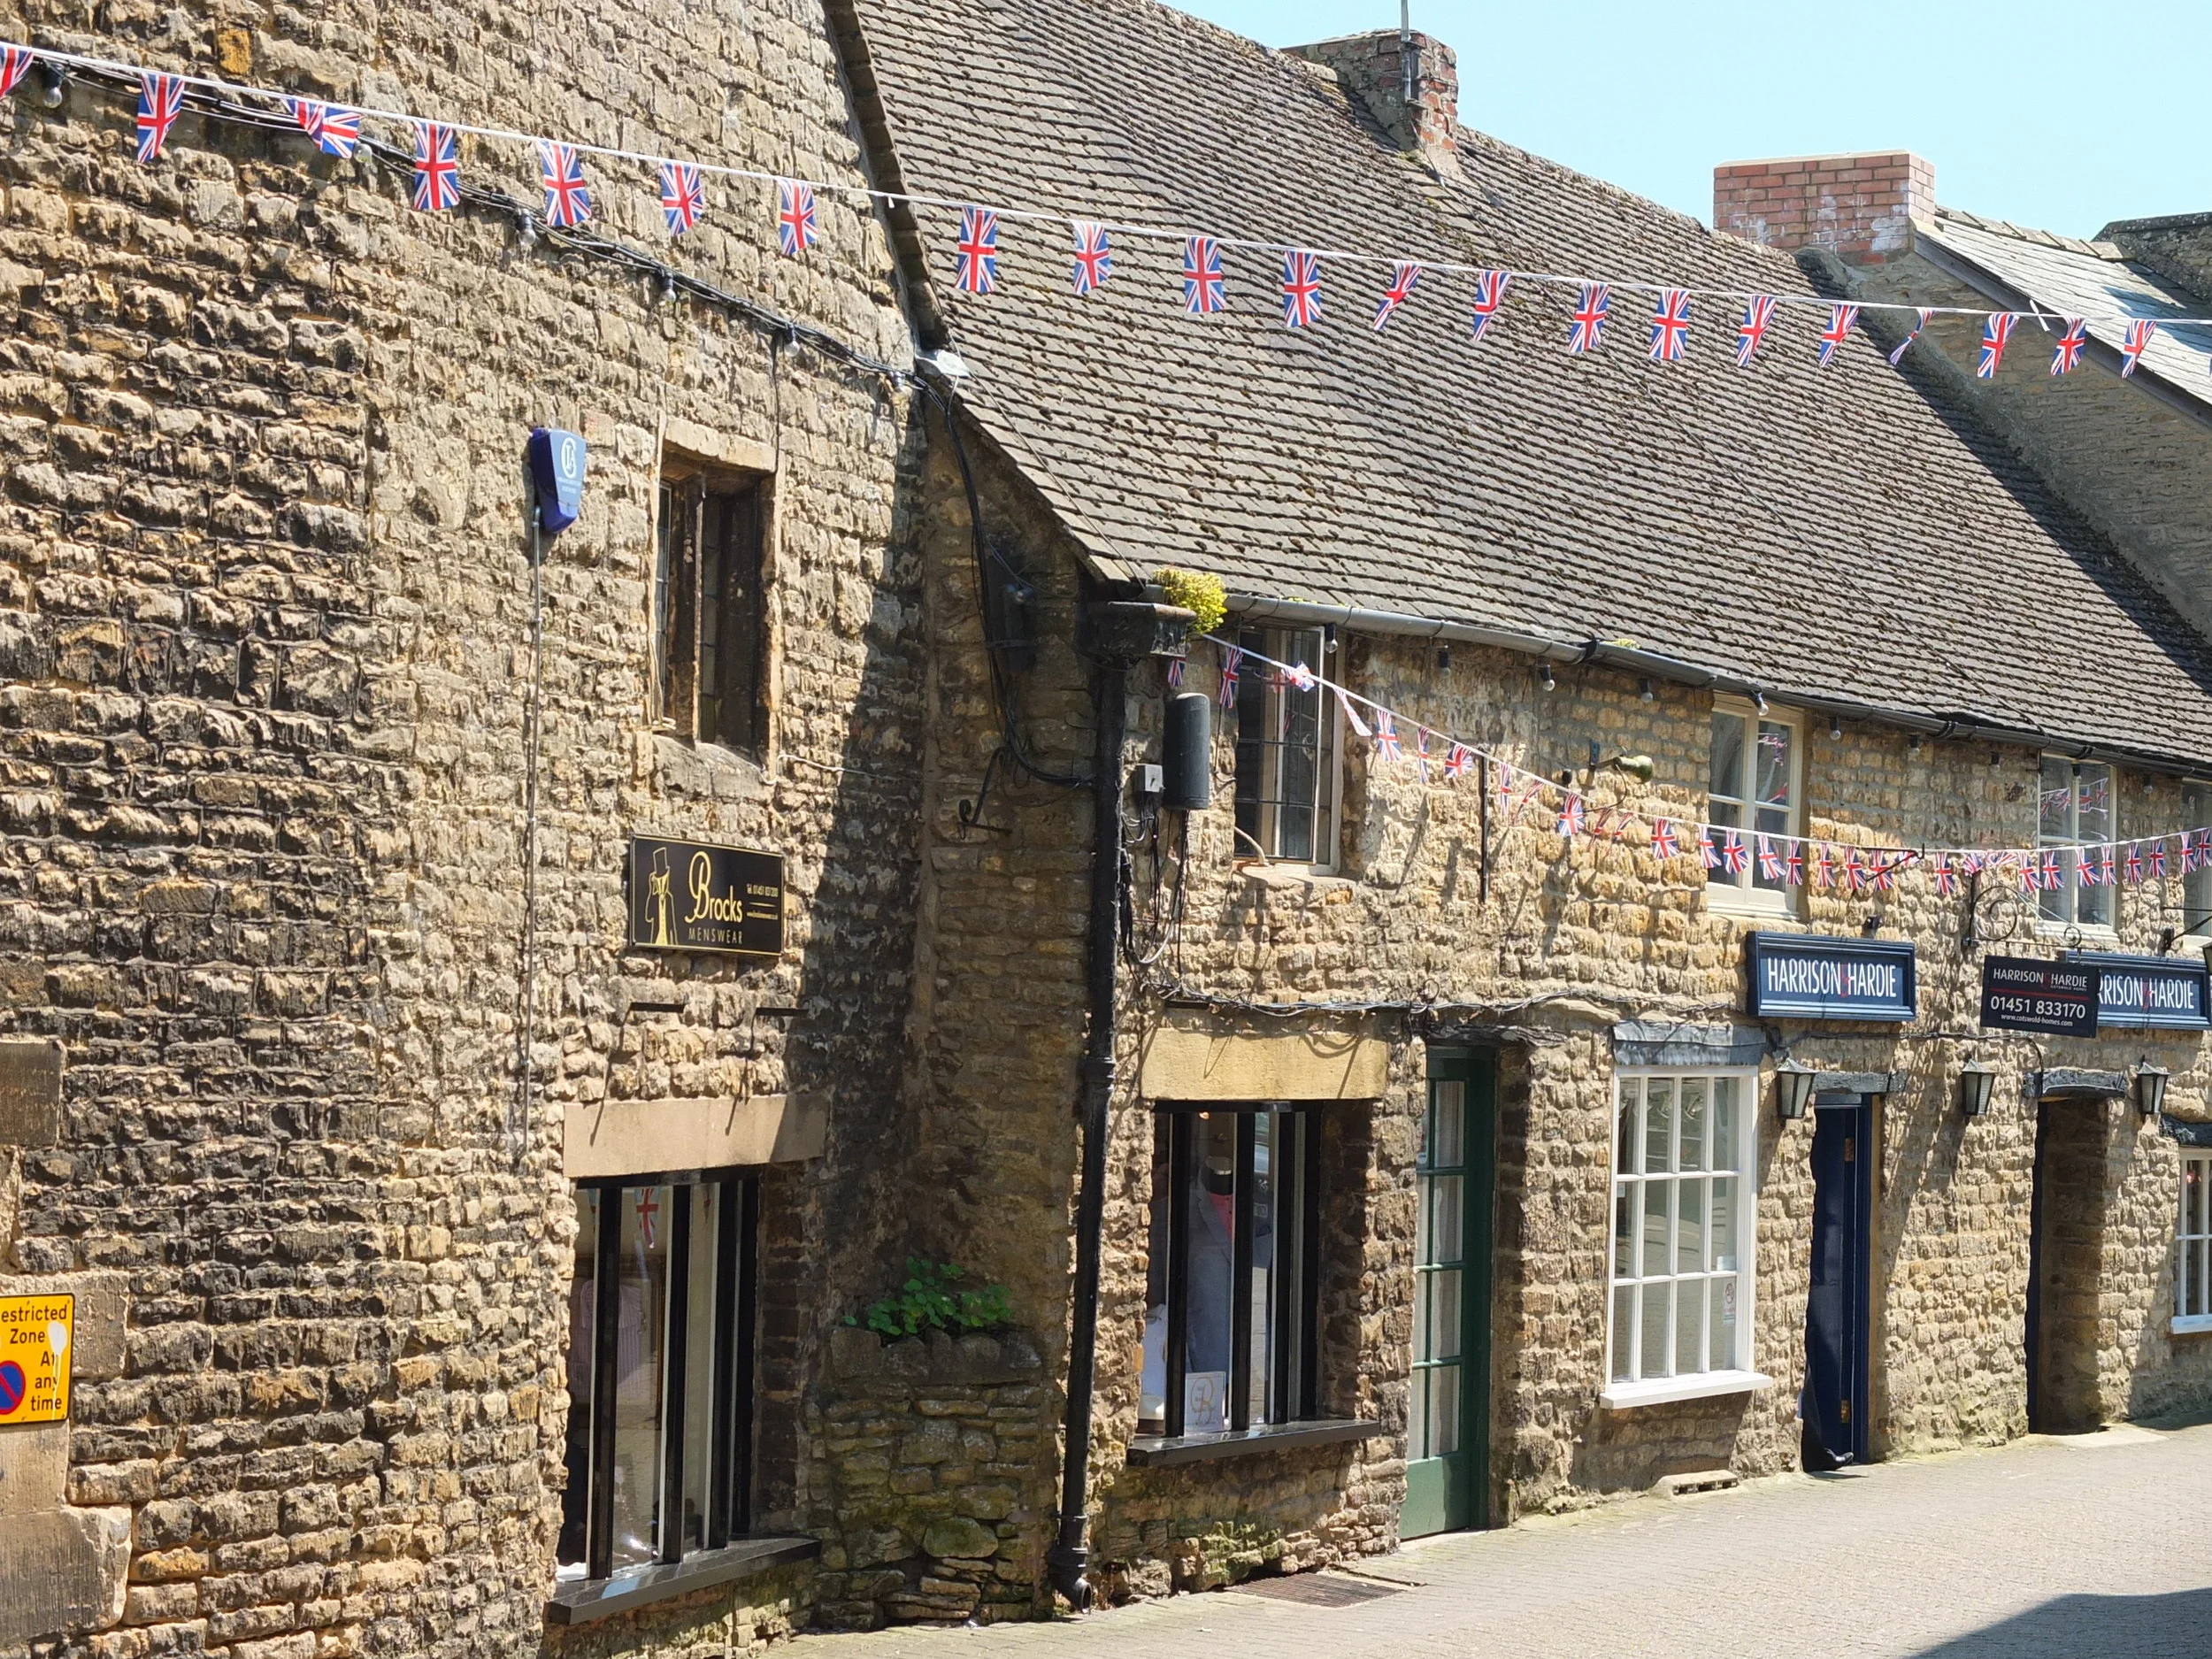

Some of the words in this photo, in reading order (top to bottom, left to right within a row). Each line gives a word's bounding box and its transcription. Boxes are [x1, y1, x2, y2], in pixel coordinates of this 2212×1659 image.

[685, 851, 742, 923] Brocks
[688, 926, 743, 945] MENSWEAR
[1768, 957, 1841, 995] HARRISON
[1847, 962, 1897, 998] HARDIE
[1993, 968, 2044, 984] HARRISON
[2050, 973, 2088, 988] HARDIE
[2097, 974, 2144, 1007] RRISON
[2148, 978, 2194, 1010] HARDIE
[1990, 995, 2031, 1014] 01451
[2036, 1000, 2086, 1019] 833170
[2001, 1014, 2073, 1027] www.cotswold-homes.com
[1, 1304, 67, 1323] estricted
[10, 1328, 46, 1344] Zone
[30, 1395, 62, 1411] time
